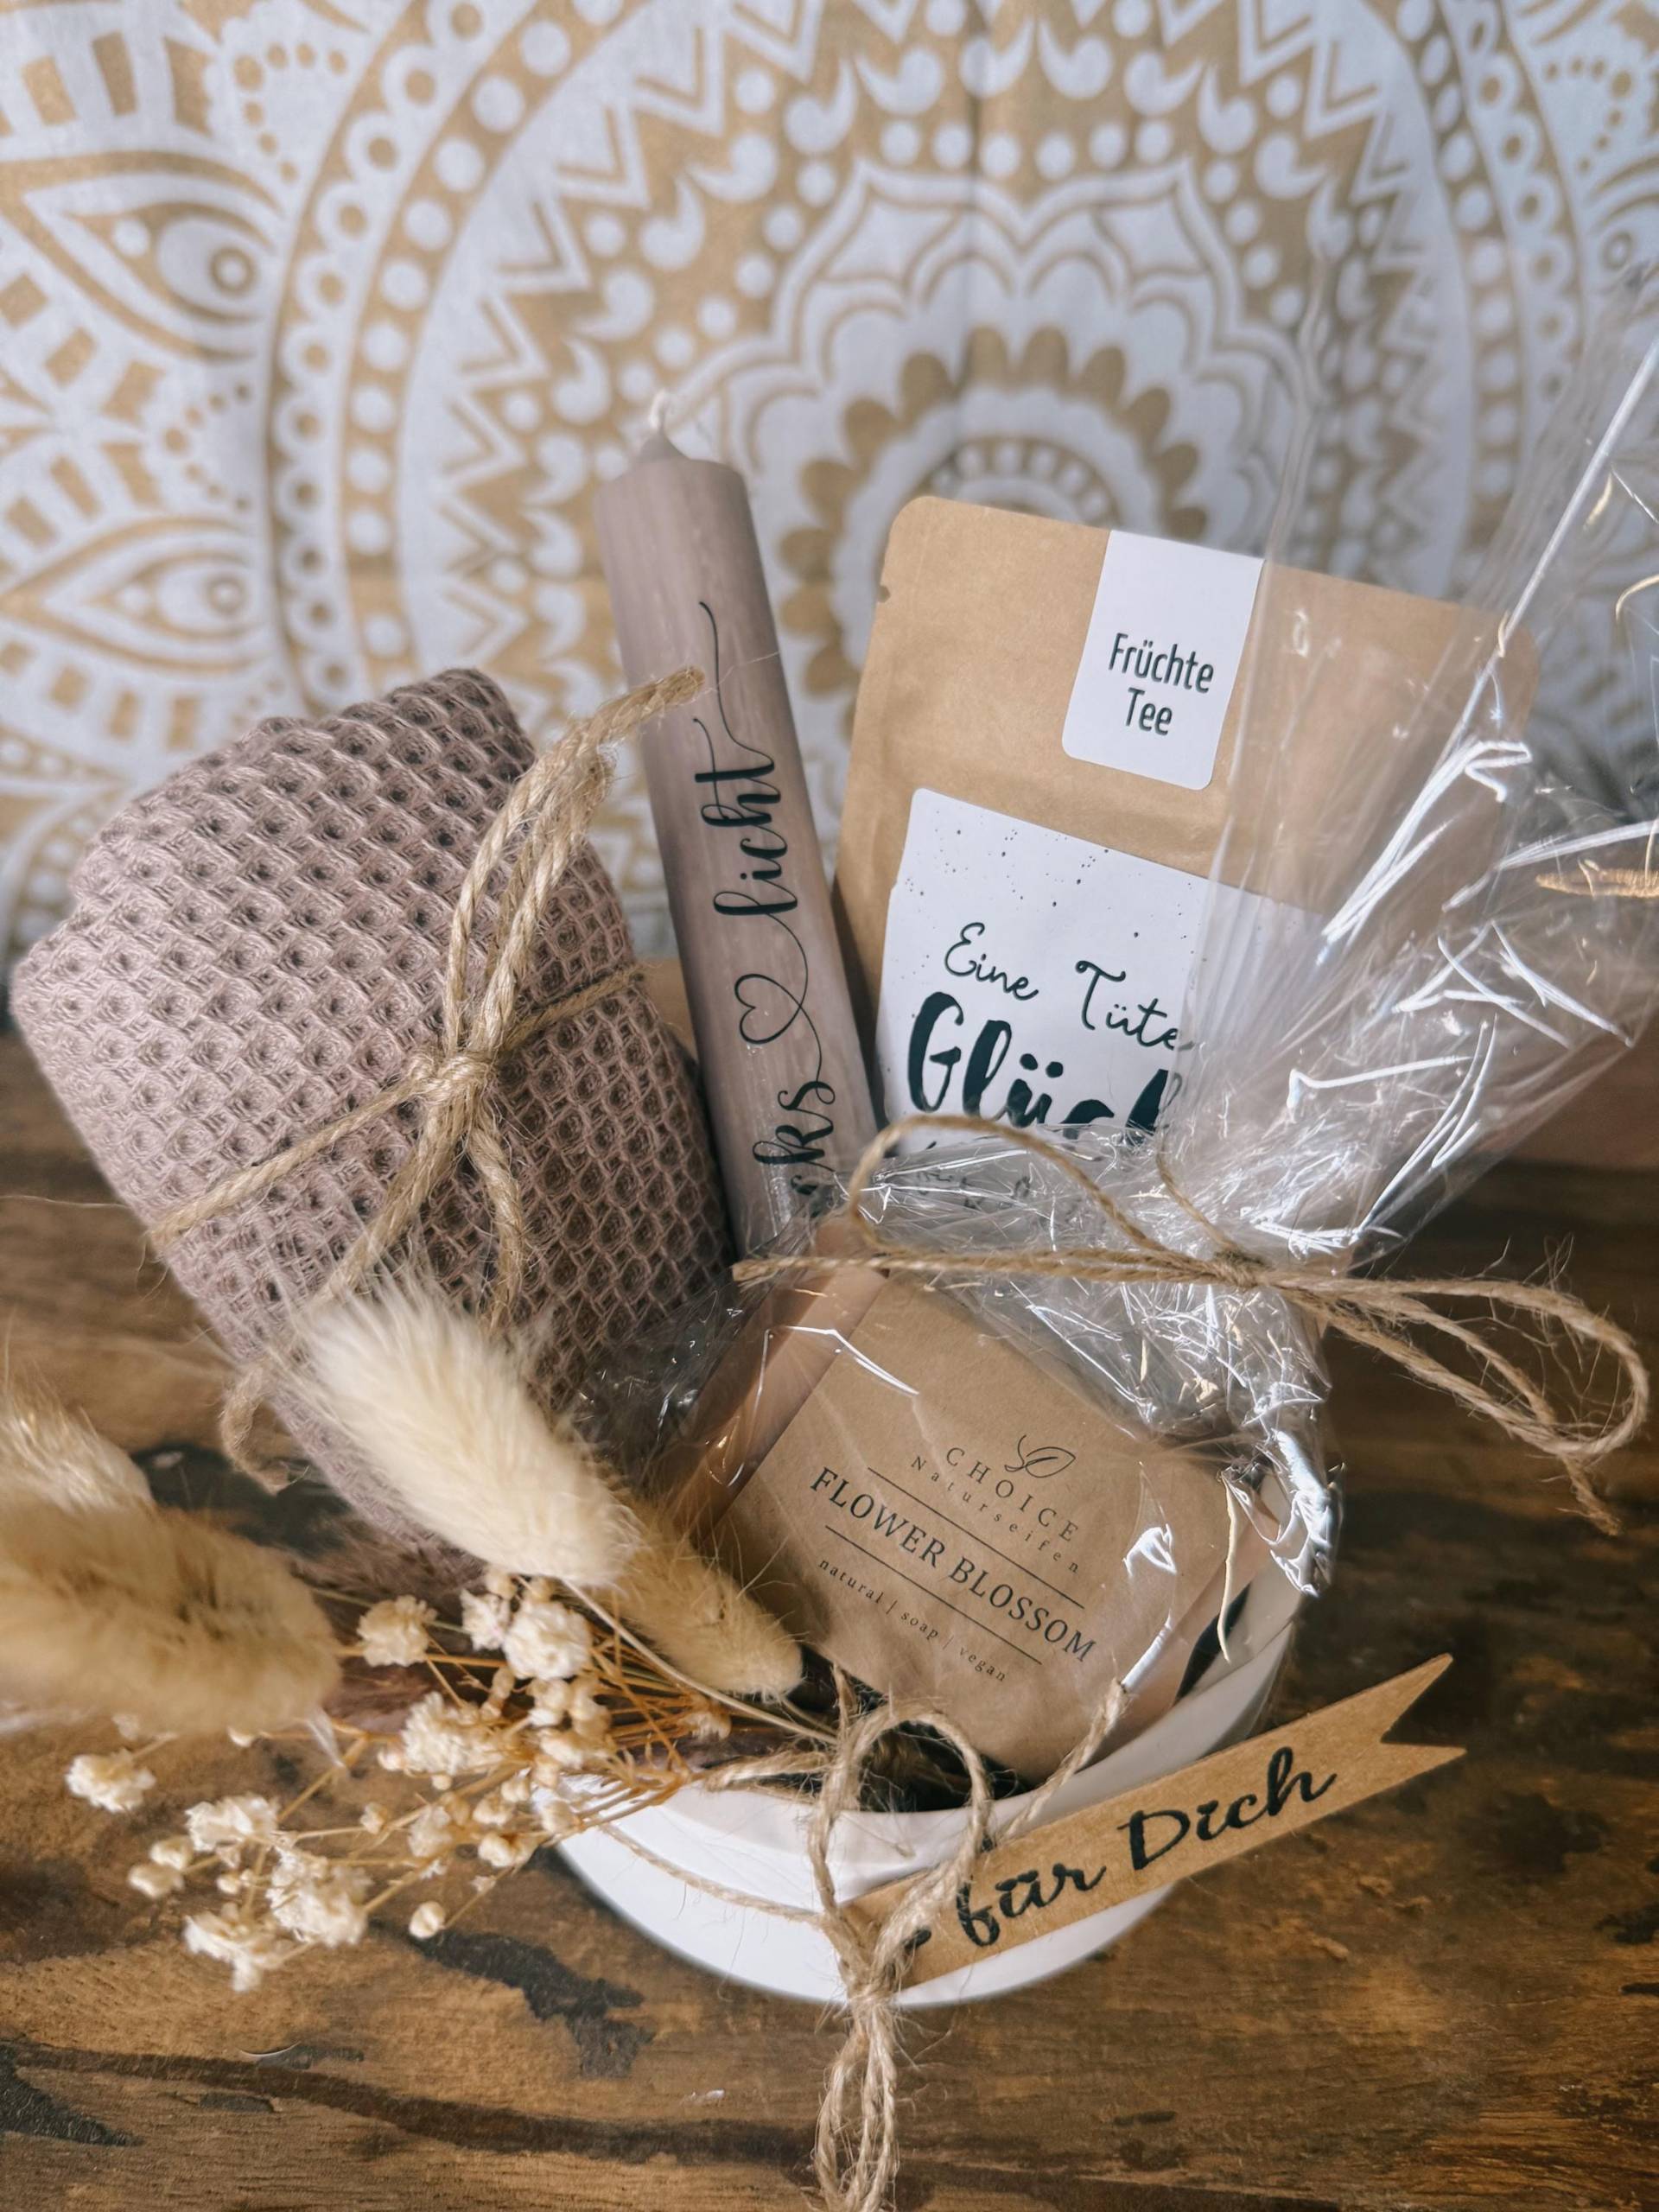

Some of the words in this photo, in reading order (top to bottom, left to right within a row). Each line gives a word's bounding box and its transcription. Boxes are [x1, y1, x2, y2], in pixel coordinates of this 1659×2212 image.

[1108, 632, 1215, 695] Früchte
[1124, 688, 1173, 736] Tee
[944, 921, 1039, 1001] Eine
[1074, 959, 1194, 1052] Tüte
[911, 1455, 1080, 1574] Naturseifen
[946, 1446, 1079, 1541] CHOICE
[809, 1466, 946, 1567] FLOWER
[948, 1555, 1096, 1662] BLOSSOM
[817, 1558, 885, 1605] natural
[900, 1609, 940, 1641] soap
[958, 1647, 1007, 1682] vegan
[1116, 1745, 1338, 1872] Dich
